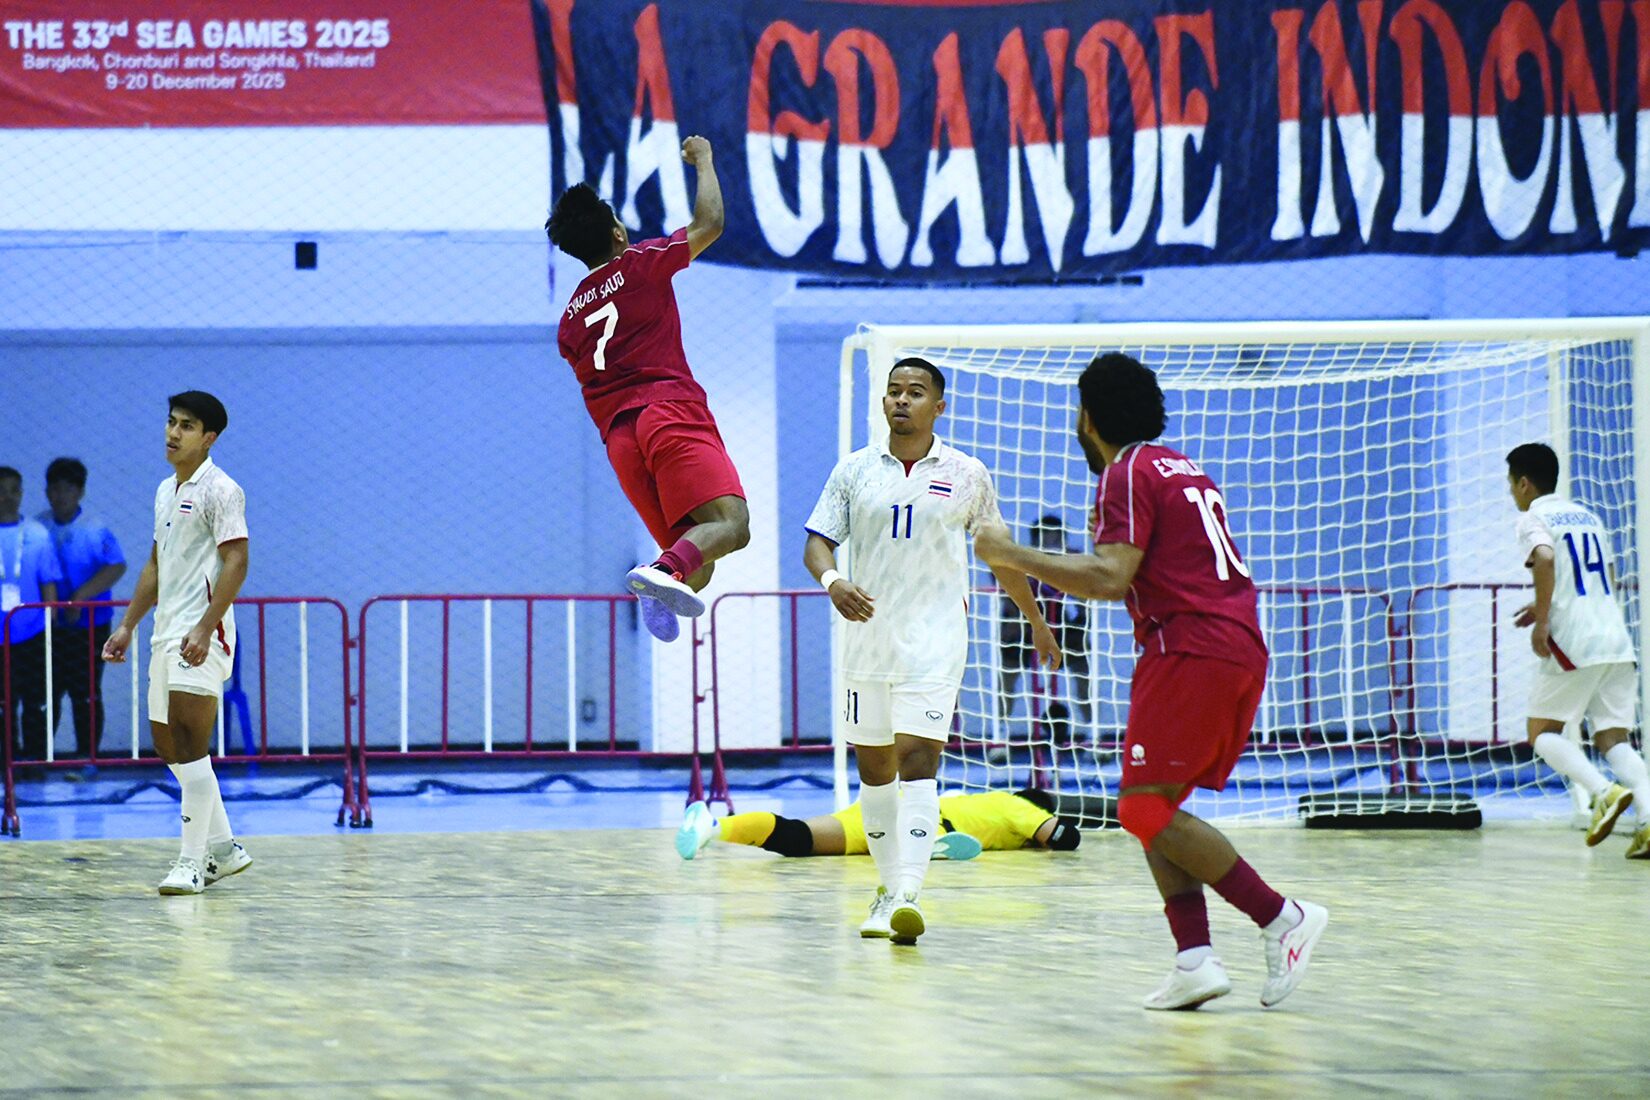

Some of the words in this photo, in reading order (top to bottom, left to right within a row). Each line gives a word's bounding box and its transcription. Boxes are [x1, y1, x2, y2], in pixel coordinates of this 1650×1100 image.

[4, 20, 65, 49] THE
[72, 20, 129, 49] 33rd
[136, 20, 195, 48] SEA
[203, 20, 308, 49] GAMES
[315, 19, 390, 48] 2025
[23, 53, 99, 72] Bangkok,
[103, 52, 180, 69] Chonburi
[184, 52, 215, 69] and
[219, 51, 300, 71] Songkhla,
[303, 51, 376, 68] Thailand
[105, 73, 148, 90] 9-20
[152, 73, 237, 90] December
[241, 72, 286, 89] 2025
[543, 0, 695, 238] LA
[745, 11, 1222, 272] GRANDE
[584, 301, 619, 371] 7
[891, 504, 913, 539] 11
[1183, 486, 1250, 581] 10
[1562, 532, 1610, 597] 14
